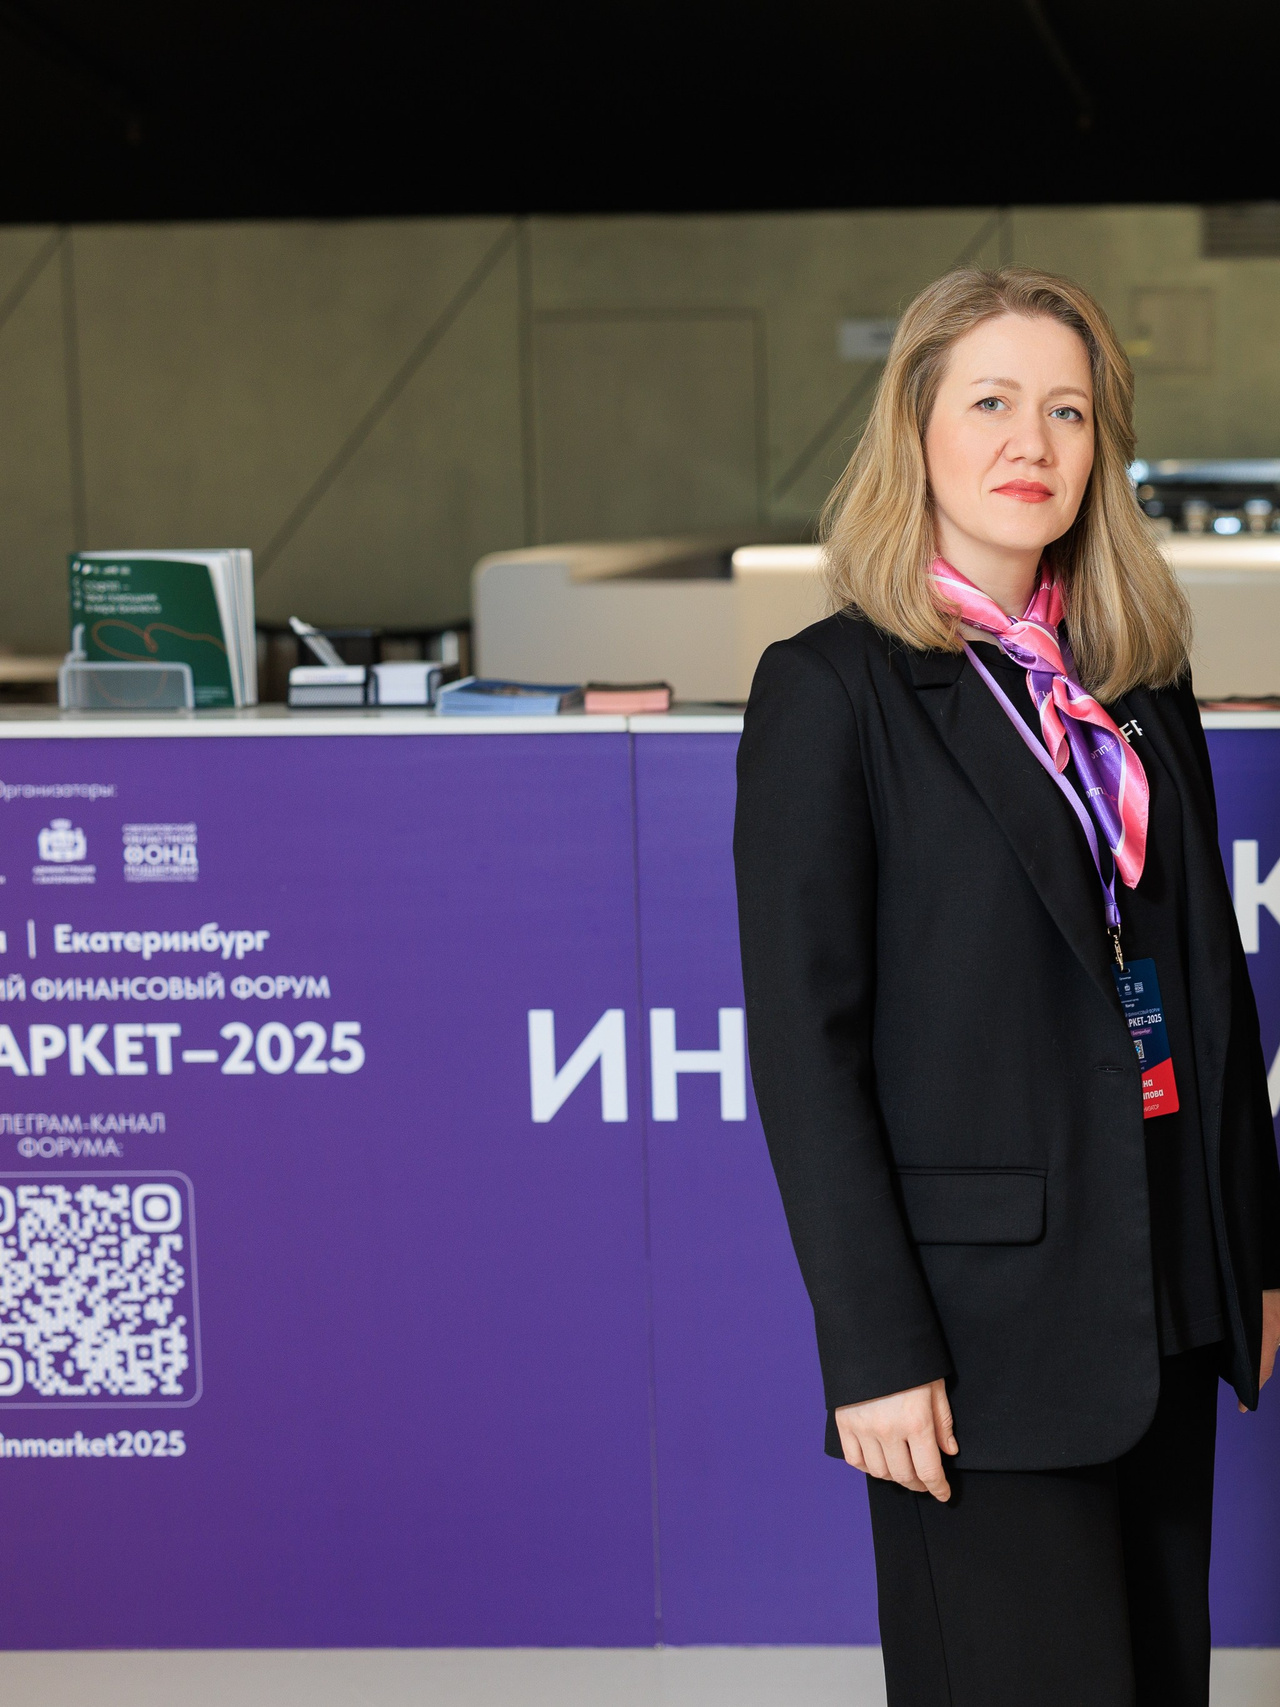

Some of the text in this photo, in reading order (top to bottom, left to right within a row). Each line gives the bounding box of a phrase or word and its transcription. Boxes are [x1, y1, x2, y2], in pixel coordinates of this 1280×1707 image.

[123, 844, 198, 866] ФОНД
[54, 920, 270, 960] Екатеринбург
[31, 971, 226, 1002] ФИНАНСОВЫЙ
[230, 975, 332, 1000] ФОРУМ
[527, 1008, 748, 1124] ИН
[1142, 1079, 1153, 1088] на
[0, 1430, 187, 1458] inmarket2025
